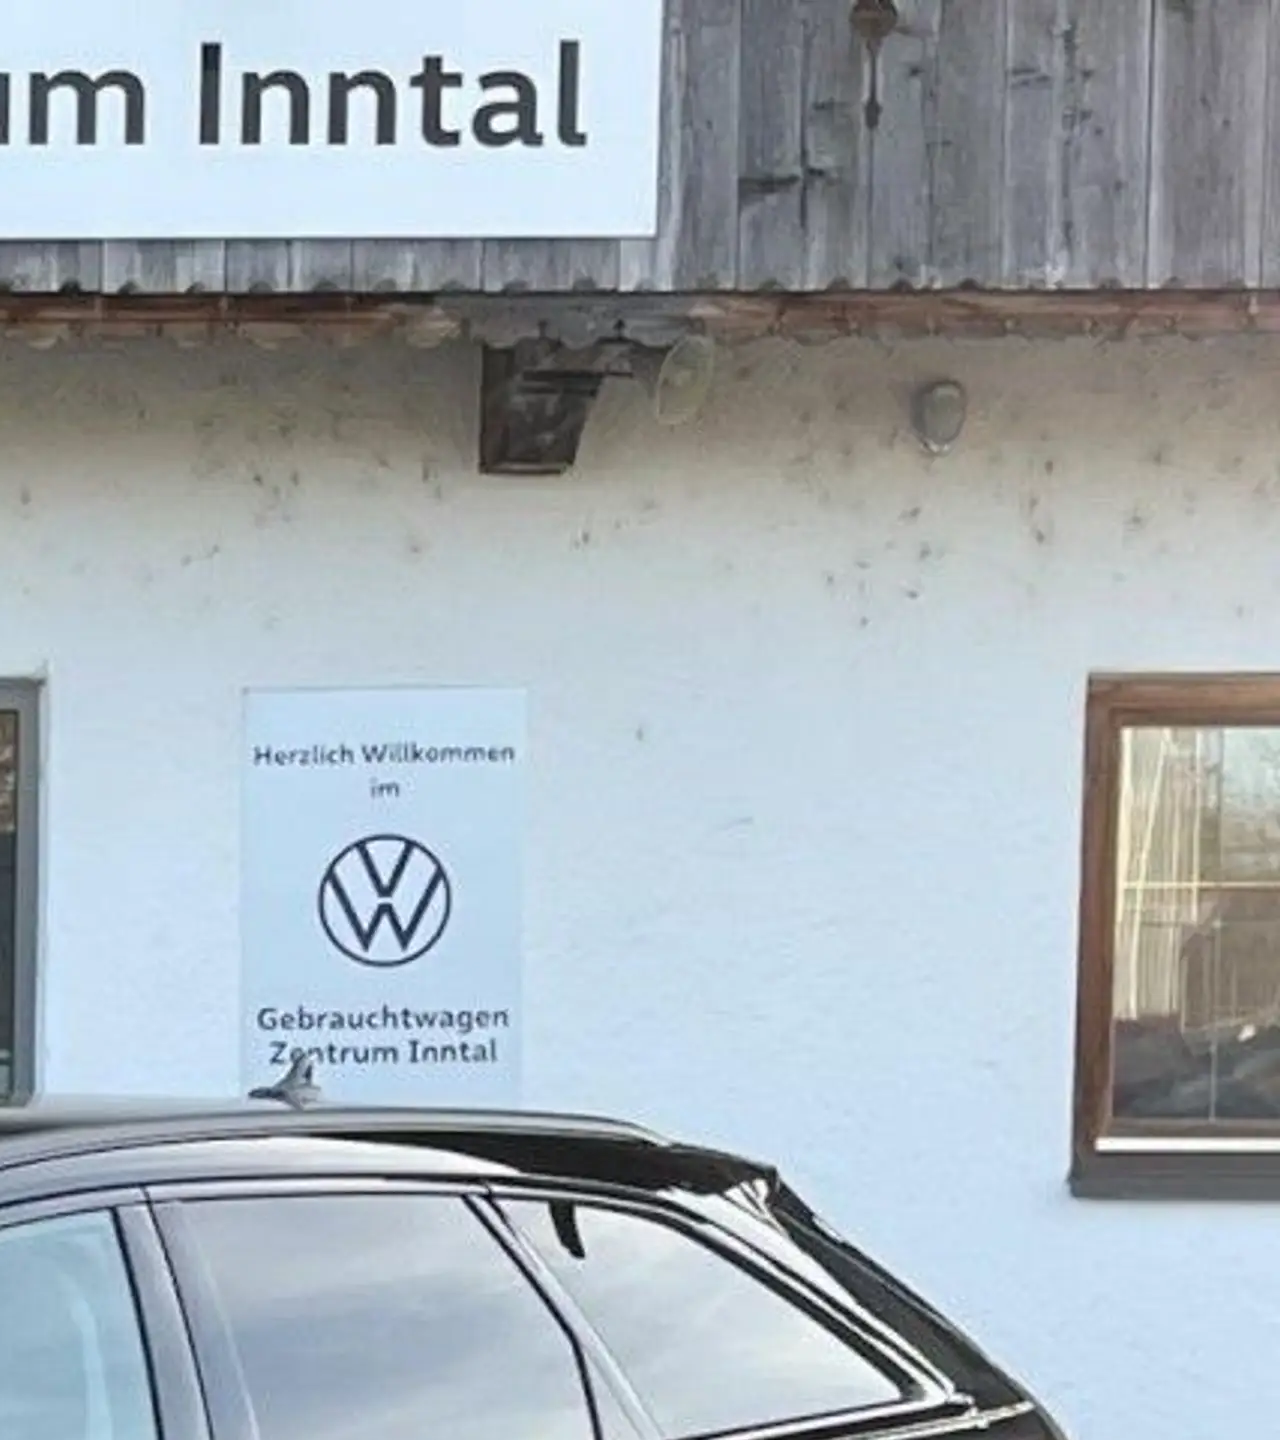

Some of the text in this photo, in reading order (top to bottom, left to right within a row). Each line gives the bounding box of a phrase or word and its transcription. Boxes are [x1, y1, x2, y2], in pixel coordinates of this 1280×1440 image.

[198, 40, 588, 148] Inntal
[253, 741, 516, 767] Herzlich Willkommen
[370, 777, 402, 799] im
[256, 1005, 509, 1034] Gebrauchtwagen
[269, 1038, 498, 1065] Zentrum Inntal
